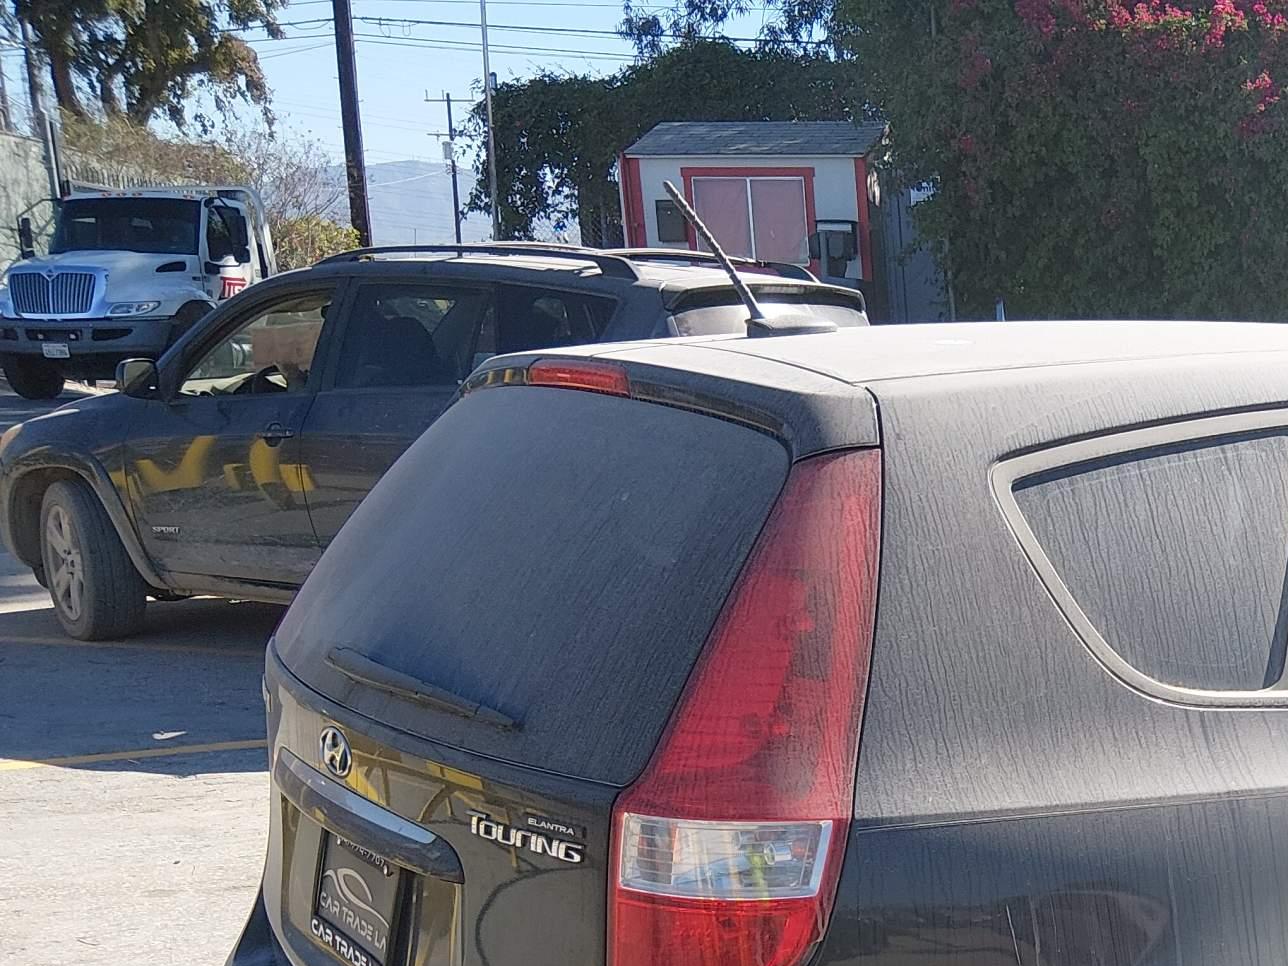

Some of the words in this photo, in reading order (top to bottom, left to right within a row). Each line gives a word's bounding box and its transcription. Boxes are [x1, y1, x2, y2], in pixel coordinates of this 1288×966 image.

[151, 526, 180, 534] SPORT
[527, 817, 575, 836] ELANTRA
[311, 918, 333, 948] CAR
[320, 891, 340, 918] CAR
[342, 906, 374, 942] TRADE
[374, 930, 387, 953] LA
